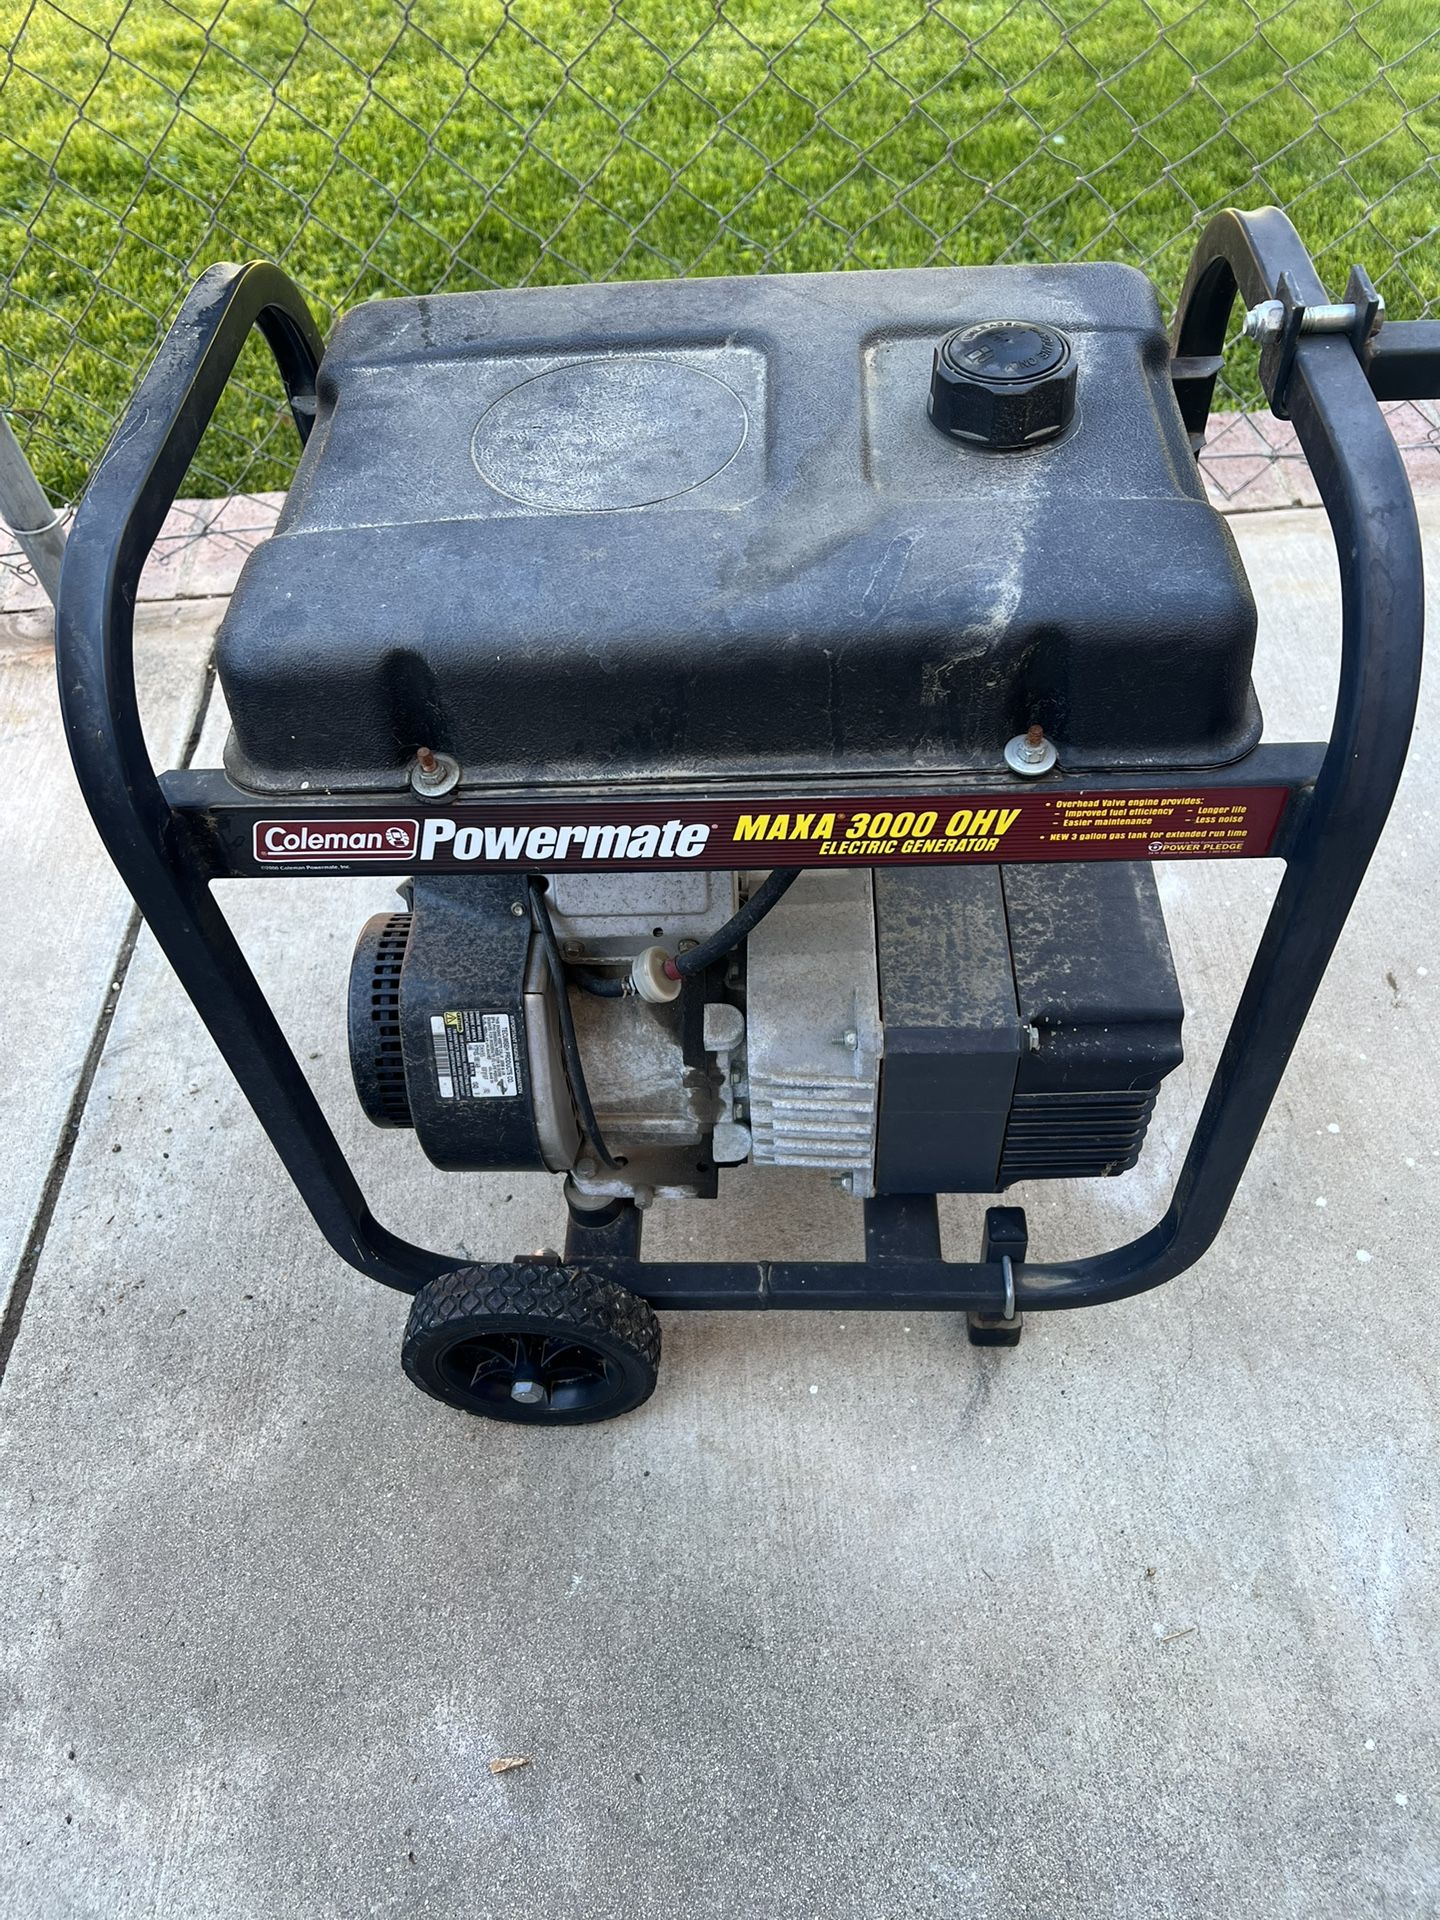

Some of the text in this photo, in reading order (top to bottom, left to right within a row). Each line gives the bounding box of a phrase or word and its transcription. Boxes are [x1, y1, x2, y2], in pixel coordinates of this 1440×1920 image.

[1056, 797, 1204, 808] Overhead Valve engine provides:
[1065, 807, 1174, 818] Improved fuel efficiency
[1198, 805, 1247, 815] Longer life
[732, 808, 1022, 841] MAXA 3000 OHV
[1063, 818, 1153, 827] Easier maintenance
[1195, 815, 1244, 824] Less noise
[264, 827, 382, 851] Coleman
[419, 818, 711, 861] Powermate
[1050, 833, 1069, 841] NEW
[1079, 832, 1107, 841] gallon
[1108, 832, 1126, 840] gas
[1127, 831, 1147, 839] tank
[1149, 831, 1164, 839] for
[1165, 830, 1207, 838] extended
[1227, 829, 1248, 837] time
[819, 837, 999, 855] ELECTRIC GENERATOR
